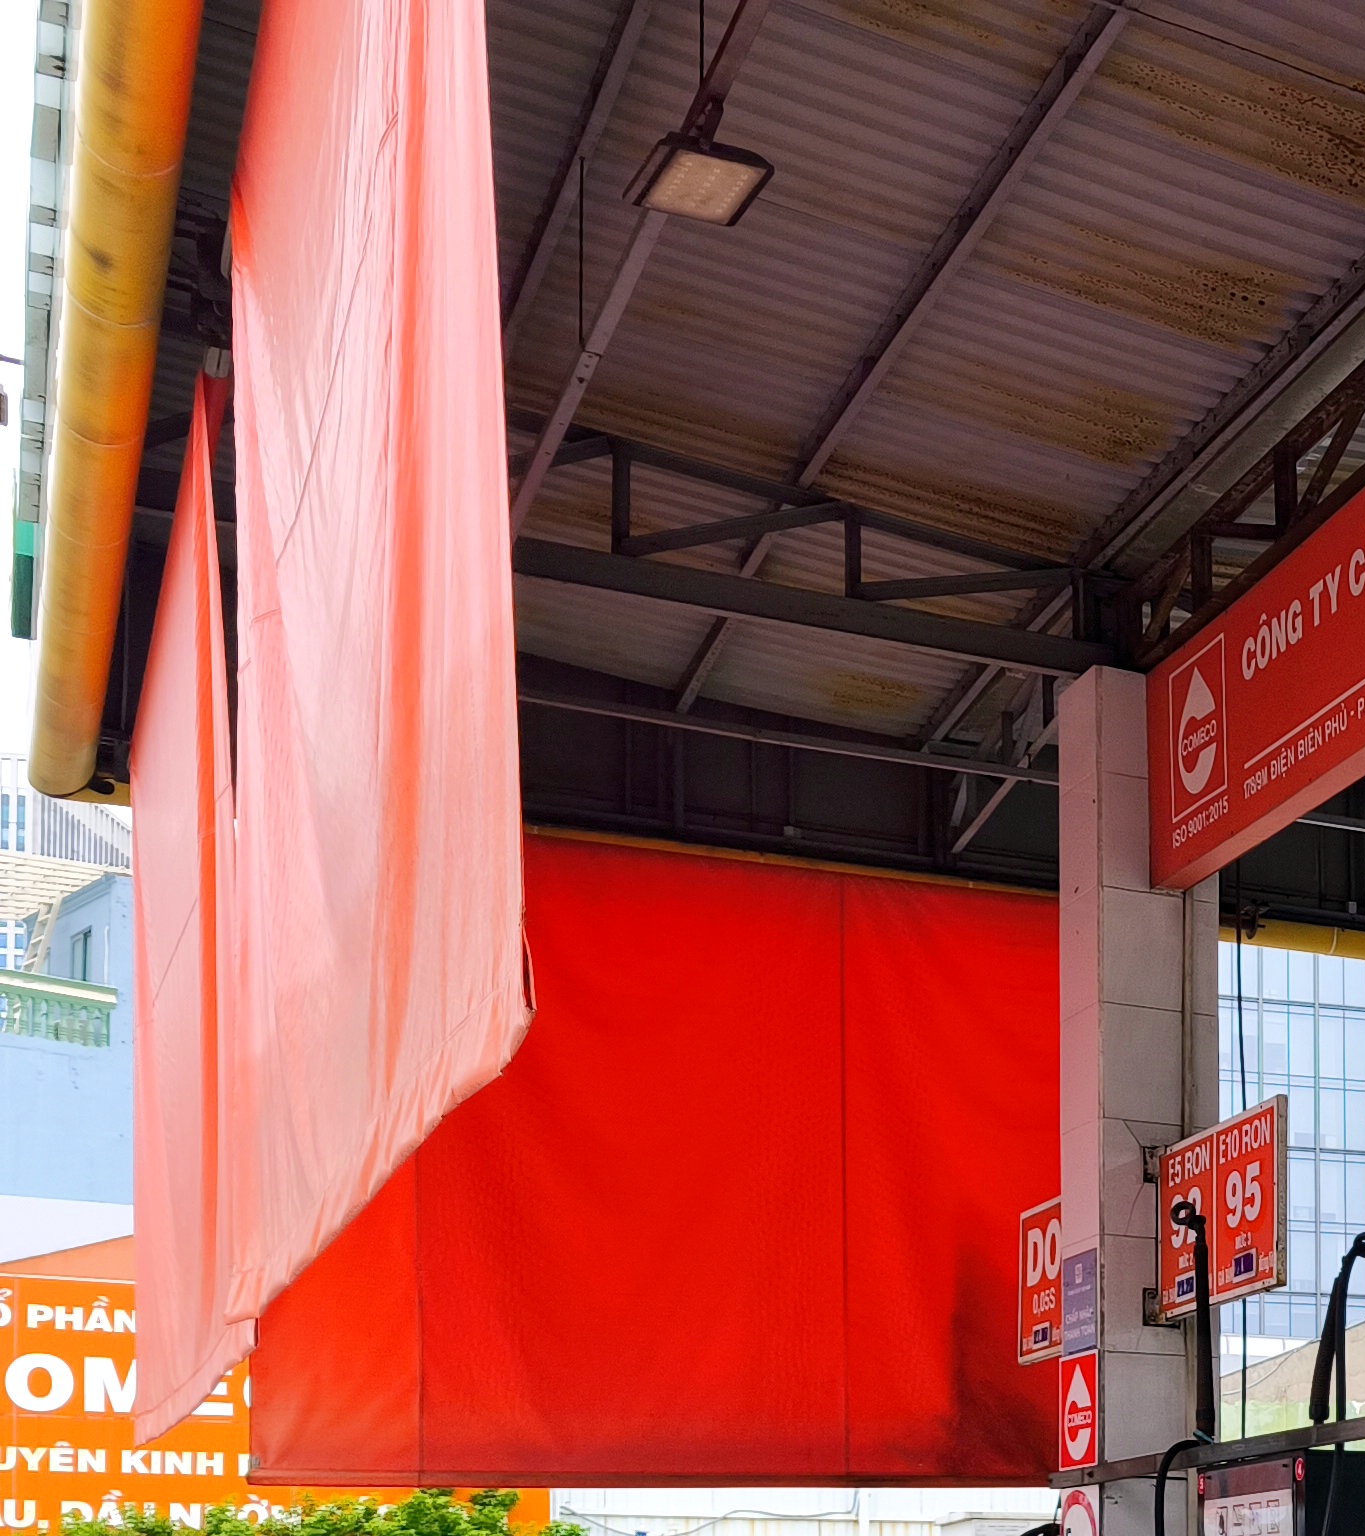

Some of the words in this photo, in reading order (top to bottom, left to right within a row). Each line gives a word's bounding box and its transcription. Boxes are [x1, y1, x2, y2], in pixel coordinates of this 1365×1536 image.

[1241, 599, 1303, 681] CÔNG
[1309, 565, 1341, 628] TY
[1181, 718, 1217, 757] COMECO
[1270, 745, 1295, 782] ĐIỆN
[1297, 725, 1323, 761] BIÊN
[1172, 825, 1188, 850] ISO
[1219, 1128, 1240, 1165] E10
[1242, 1113, 1271, 1155] RON
[1168, 1155, 1182, 1188] E5
[1185, 1141, 1211, 1181] RON
[1225, 1160, 1262, 1229] 95
[1027, 1217, 1061, 1288] DO
[27, 1295, 136, 1334] PHẦN
[121, 1449, 224, 1477] KINH
